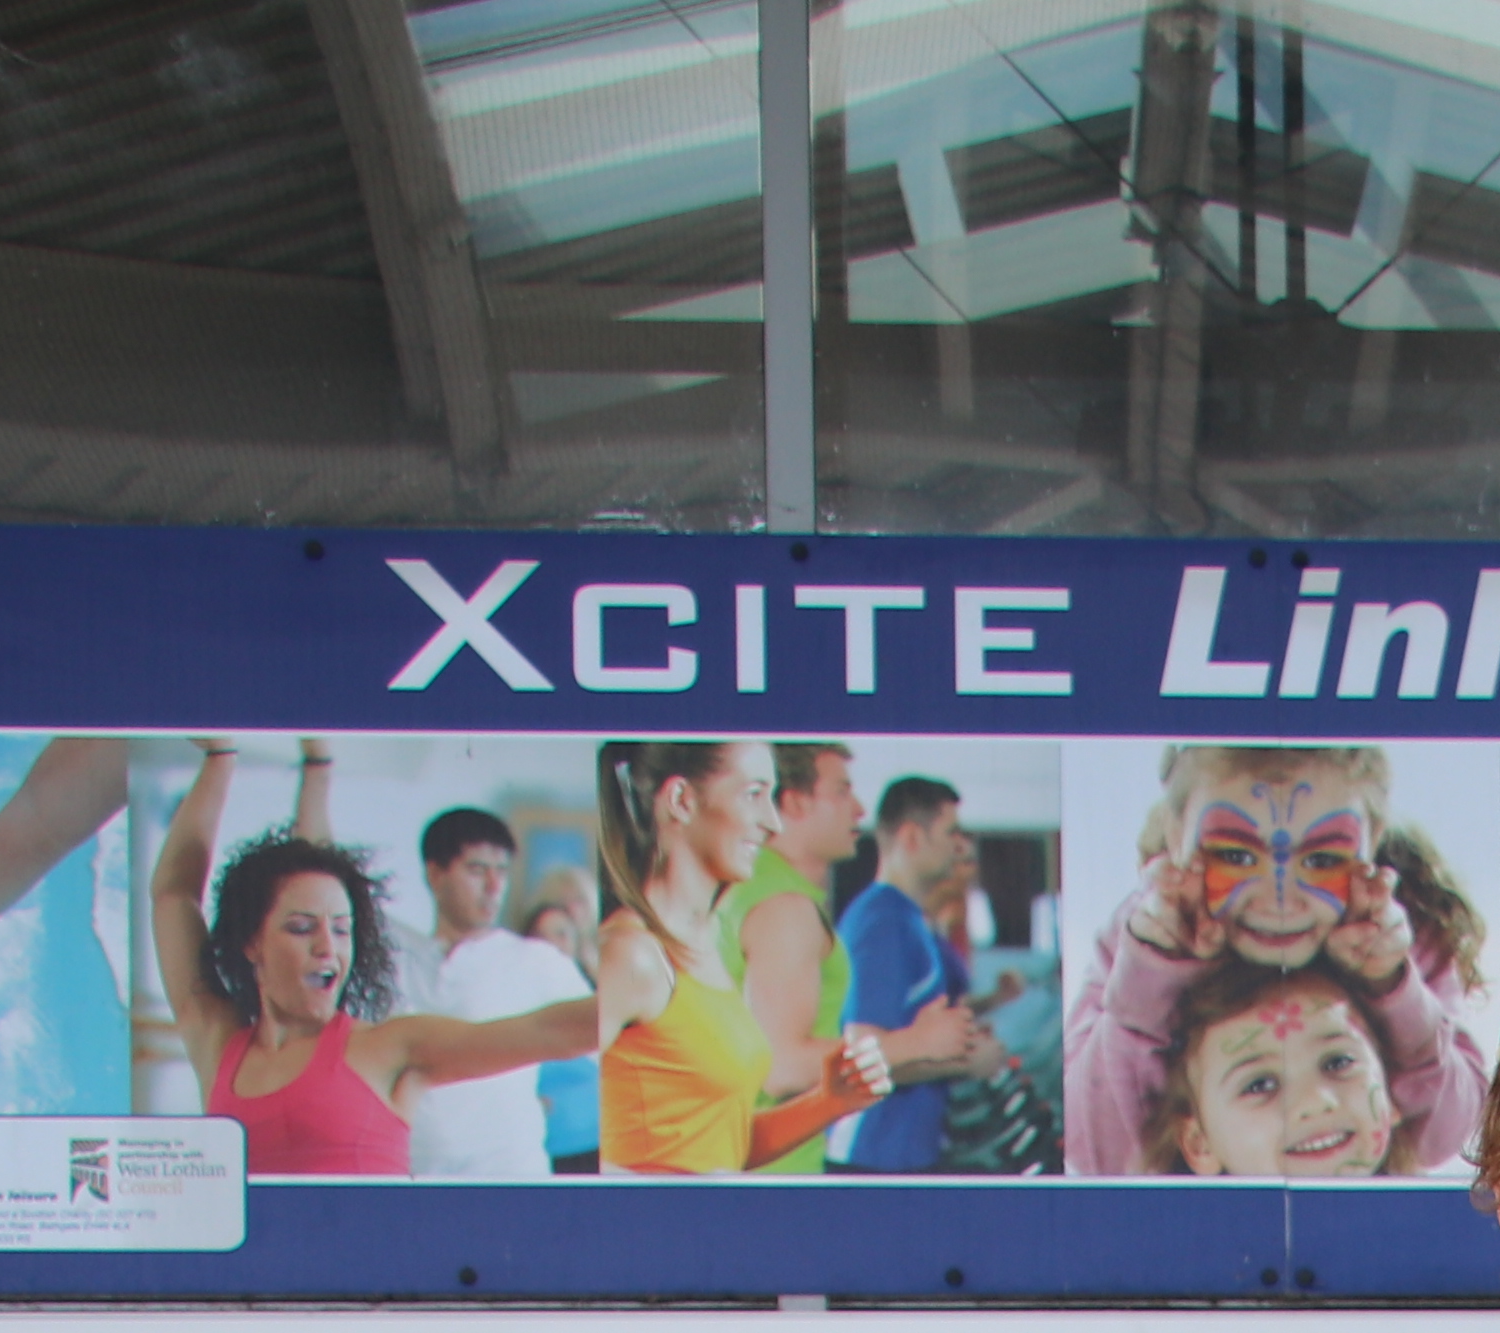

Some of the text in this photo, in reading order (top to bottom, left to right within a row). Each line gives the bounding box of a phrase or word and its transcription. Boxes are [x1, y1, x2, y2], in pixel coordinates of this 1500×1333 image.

[387, 558, 1074, 694] XCITE
[118, 1162, 227, 1177] West Lothian
